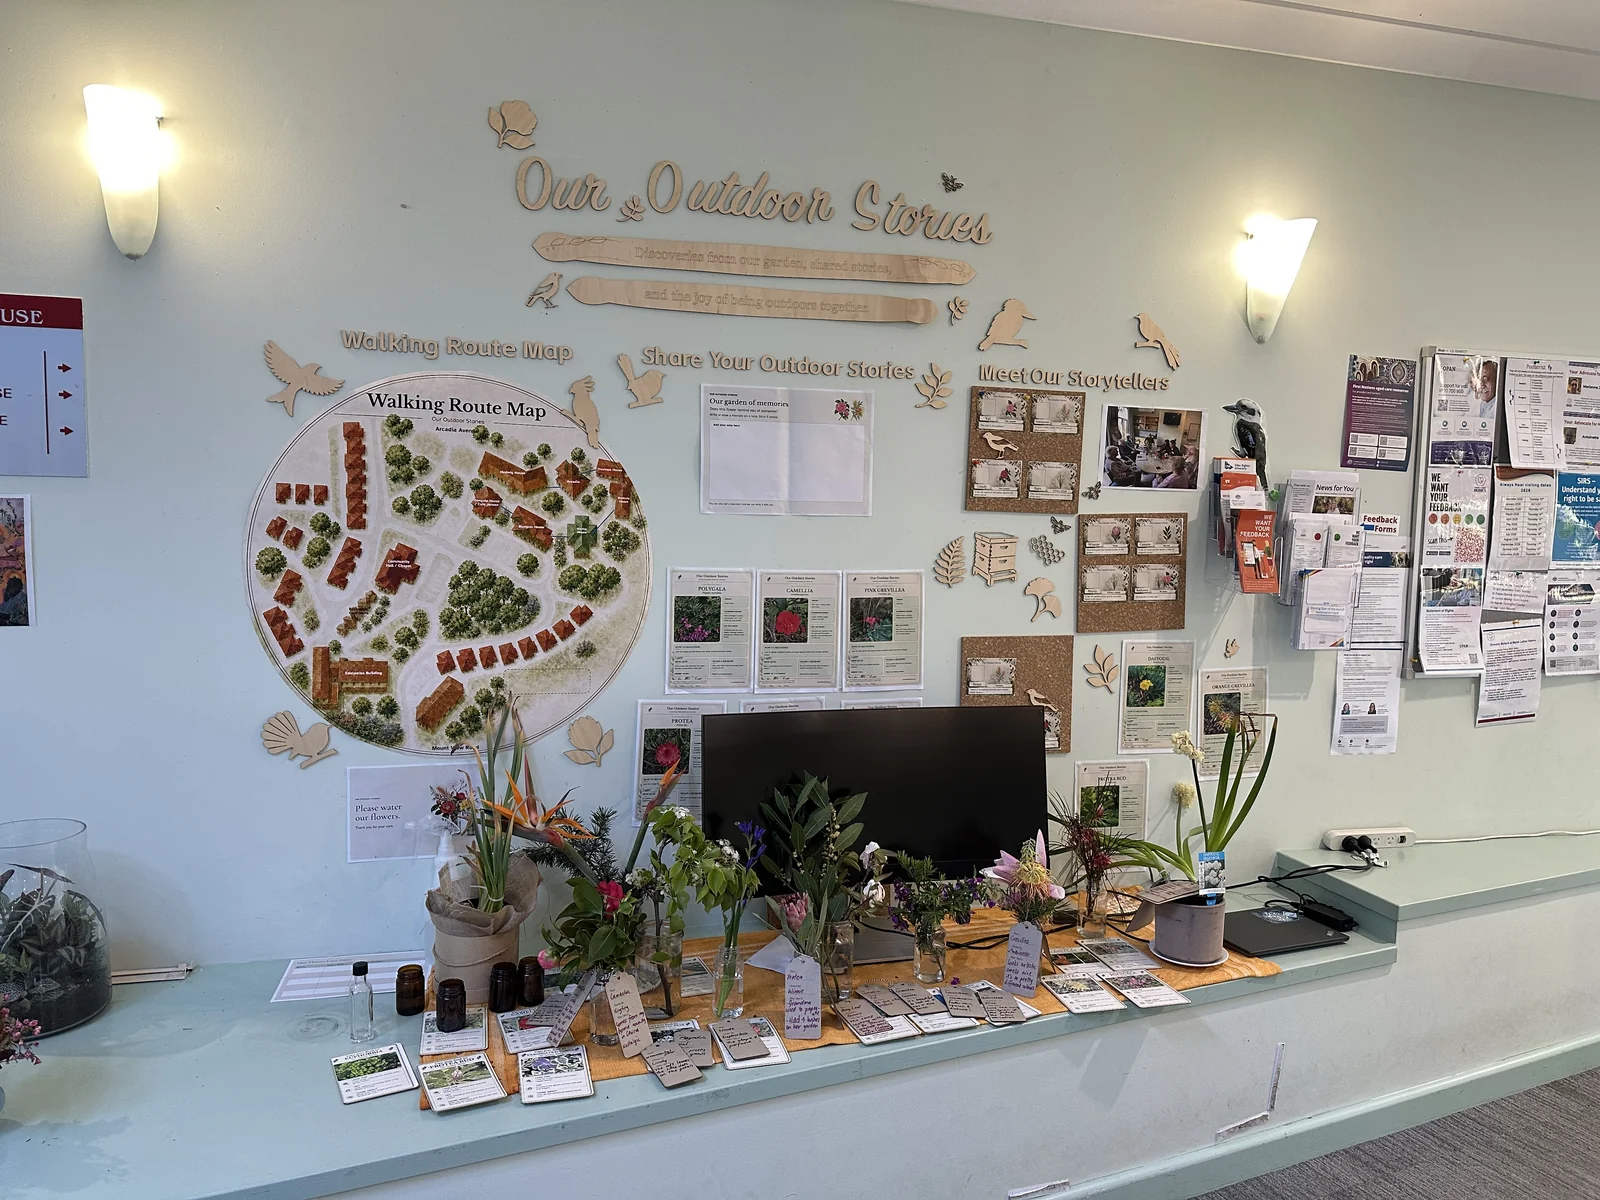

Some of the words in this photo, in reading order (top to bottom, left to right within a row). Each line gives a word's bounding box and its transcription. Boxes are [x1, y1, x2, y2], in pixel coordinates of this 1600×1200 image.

[516, 156, 612, 212] Our
[647, 160, 836, 224] Outdoor
[852, 180, 993, 245] Stories
[635, 247, 705, 263] Discoveries
[707, 252, 737, 265] from
[739, 255, 760, 267] our
[810, 259, 849, 272] shared
[851, 261, 892, 275] stories,
[645, 289, 668, 300] and
[671, 290, 691, 302] the
[692, 291, 712, 305] joy
[715, 291, 730, 305] of
[731, 293, 763, 310] being
[765, 297, 817, 310] outdoors
[340, 328, 440, 360] Walking
[446, 336, 517, 359] Route
[522, 340, 574, 365] Map
[642, 346, 704, 369] Share
[709, 351, 755, 372] Your
[760, 355, 843, 377] Outdoor
[848, 360, 916, 380] Stories
[979, 364, 1028, 384] Meet
[1030, 368, 1065, 386] Our
[1067, 370, 1170, 392] Storytellers
[366, 392, 445, 415] Walking
[449, 398, 502, 416] Route
[506, 402, 547, 421] Map
[709, 397, 723, 405] Our
[724, 398, 747, 407] garden
[748, 398, 757, 406] of
[757, 400, 789, 408] memories
[1431, 473, 1441, 482] WE
[1430, 483, 1449, 492] WANT
[1561, 486, 1596, 494] Understand
[1430, 492, 1448, 502] YOUR
[1563, 495, 1579, 503] right
[1429, 502, 1462, 512] FEEDBACK
[1363, 514, 1398, 524] Feedback
[1374, 524, 1397, 534] Forms
[355, 804, 379, 812] Please
[370, 813, 400, 821] flowers.
